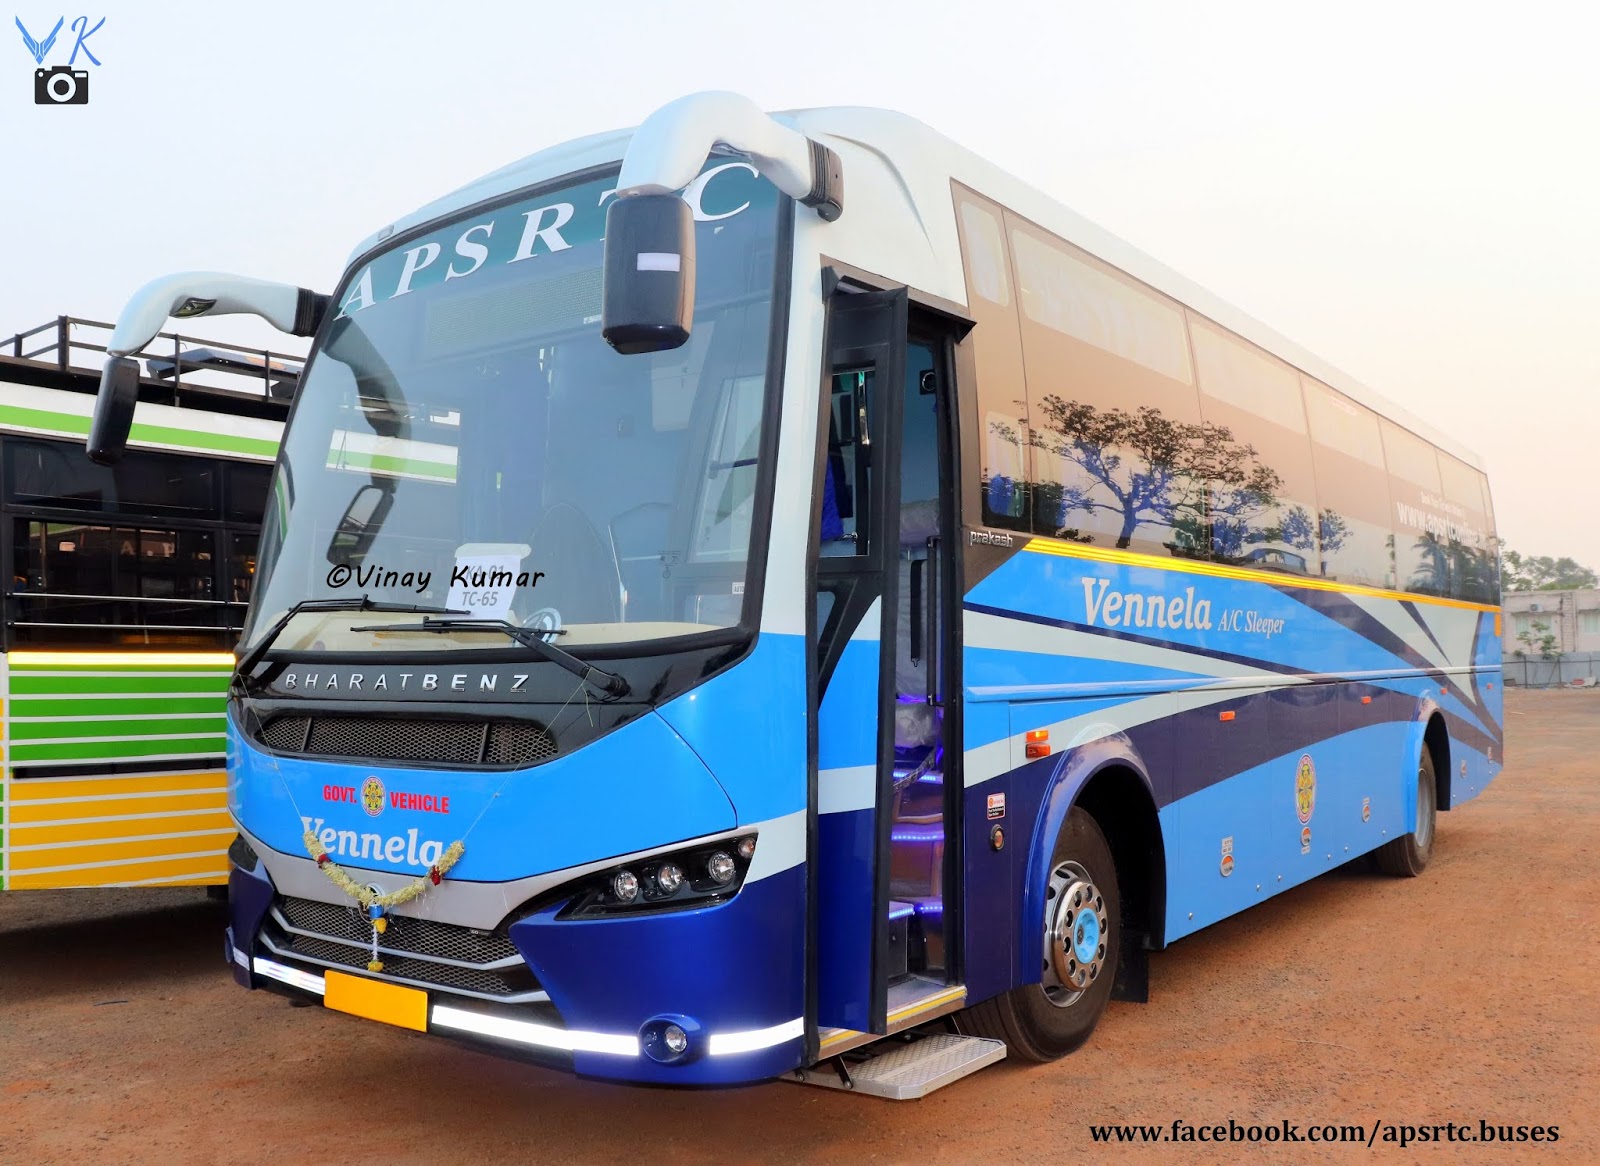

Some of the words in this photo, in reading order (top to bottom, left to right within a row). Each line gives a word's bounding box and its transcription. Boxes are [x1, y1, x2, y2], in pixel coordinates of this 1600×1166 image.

[333, 162, 760, 321] APSRC
[969, 530, 1013, 548] prakash
[461, 591, 498, 606] TC-65
[1081, 576, 1213, 630] Vennela
[1217, 609, 1244, 632] A/C
[1244, 610, 1286, 639] Sleeper
[285, 673, 530, 693] BHARATBENZ
[323, 785, 358, 803] GOVT.
[390, 791, 450, 814] VEHICLE
[301, 816, 444, 867] Vennela
